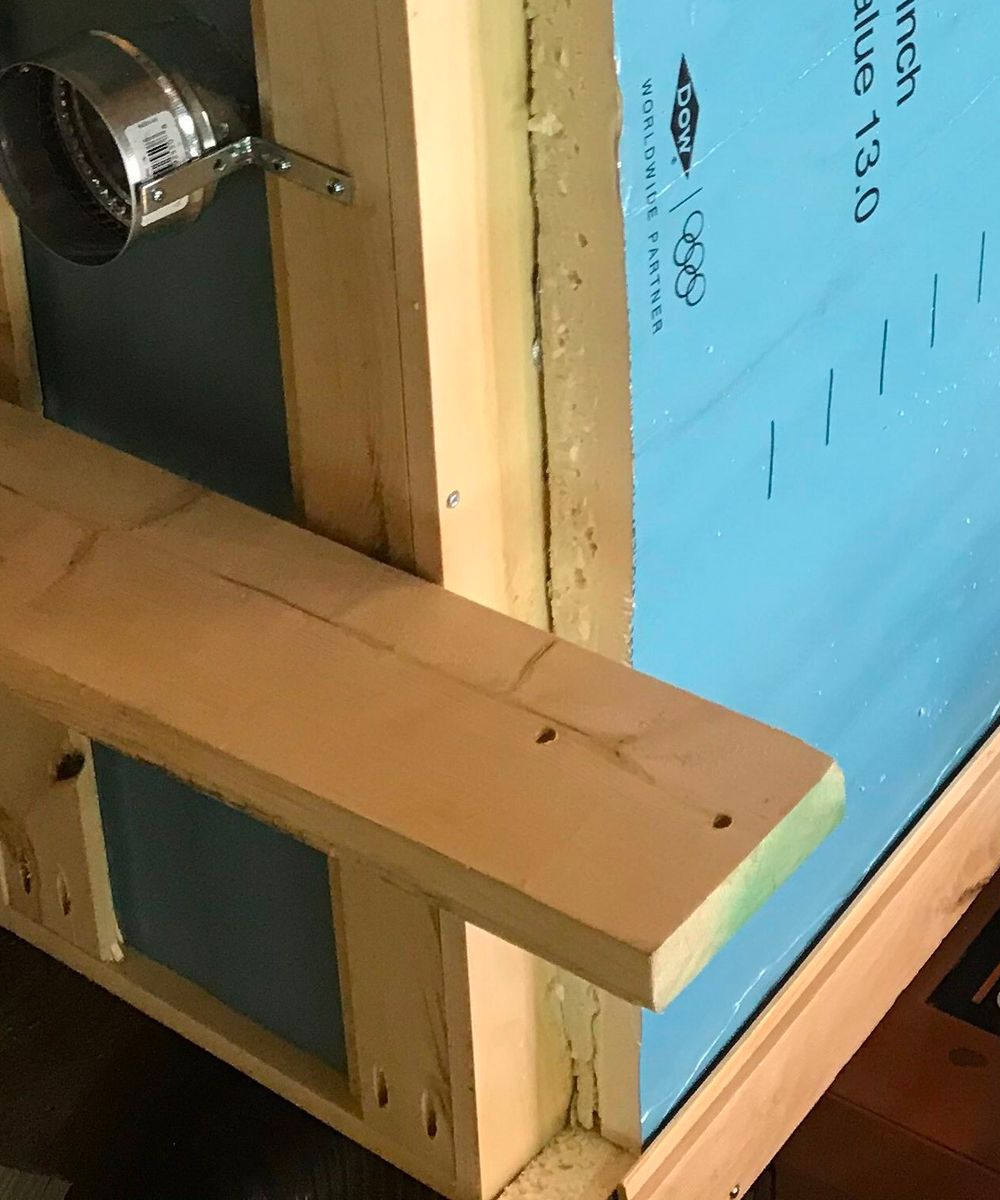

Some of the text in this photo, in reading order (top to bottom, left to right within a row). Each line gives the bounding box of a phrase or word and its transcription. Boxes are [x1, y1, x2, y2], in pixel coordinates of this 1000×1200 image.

[641, 77, 663, 336] WORLDWIDE PARTNER
[854, 109, 881, 224] 13.0
